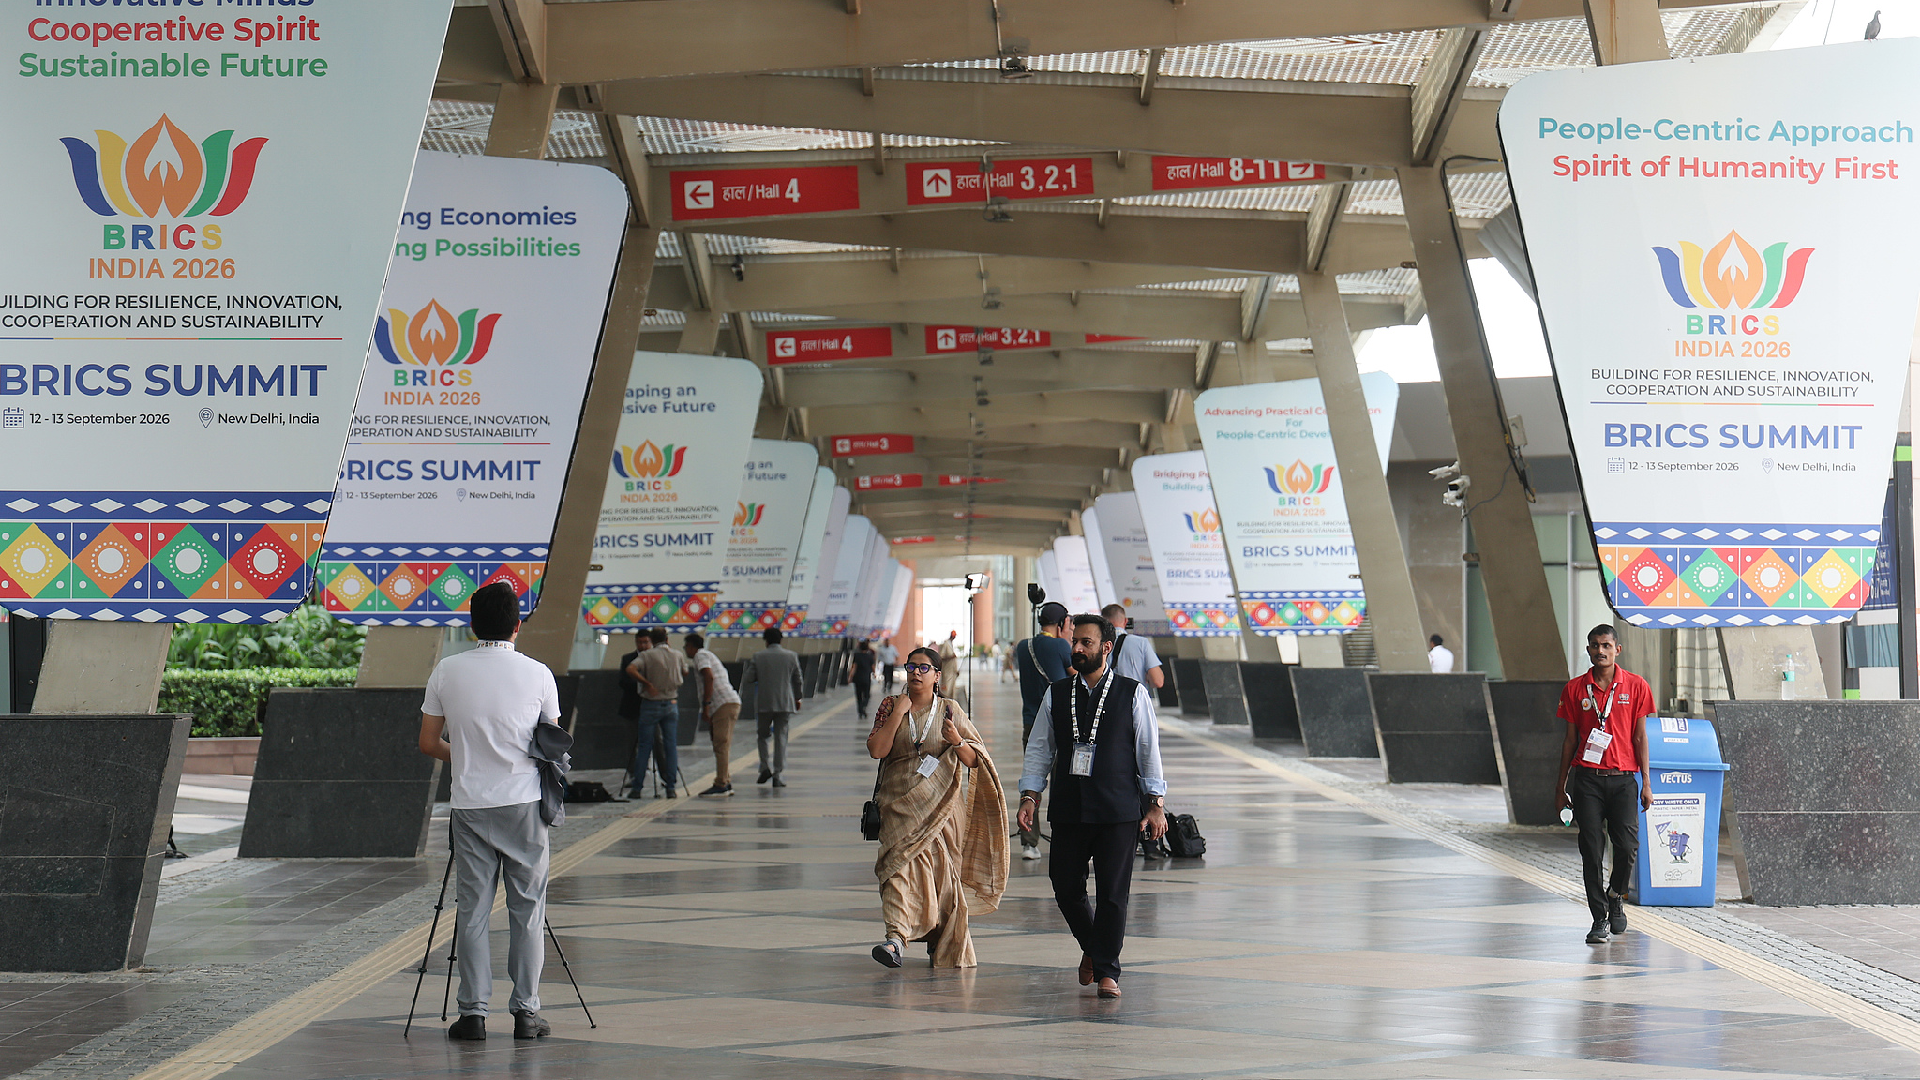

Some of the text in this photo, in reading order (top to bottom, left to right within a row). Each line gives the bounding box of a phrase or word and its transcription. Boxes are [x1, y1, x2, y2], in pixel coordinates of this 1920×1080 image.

[28, 15, 320, 47] Cooperative Spirit
[19, 51, 328, 78] Sustainable Future
[1539, 117, 1913, 147] People-Centric Approach
[1228, 158, 1282, 182] 8-11
[1553, 154, 1899, 185] Spirit of Humanity First
[1020, 164, 1077, 192] 3,2,1
[722, 186, 746, 201] हाल
[785, 178, 801, 203] 4
[440, 205, 577, 226] Economies
[103, 224, 222, 250] BRICS
[435, 237, 581, 257] Possibilities
[89, 258, 236, 279] INDIA 2026
[74, 295, 110, 309] FOR
[115, 295, 221, 311] RESILIENCE,
[226, 295, 342, 311] INNOVATION,
[2, 315, 324, 328] COOPERATION AND SUSTAINABILITY
[1686, 314, 1779, 336] BRICS
[842, 335, 853, 353] 4
[1675, 340, 1791, 358] INDIA 2026
[0, 364, 327, 397] BRICS SUMMIT
[394, 369, 472, 387] BRICS
[1591, 368, 1874, 384] BUILDING FOR RESILIENCE, INNOVATION,
[624, 384, 697, 399] aping an
[1606, 384, 1859, 398] COOPERATION AND SUSTAINABILITY
[384, 391, 481, 406] INDIA 2026
[622, 400, 716, 414] sive Future
[1205, 407, 1262, 417] Advancing
[1266, 407, 1313, 416] Practical
[30, 413, 42, 424] 12
[52, 413, 64, 424] 13
[67, 413, 137, 426] September
[140, 413, 170, 424] 2026
[218, 413, 319, 426] New Delhi, India
[374, 415, 399, 425] FOR
[402, 415, 472, 426] RESILIENCE,
[474, 415, 551, 426] INNOVATION,
[1286, 419, 1303, 427] For
[415, 427, 442, 438] AND
[444, 427, 538, 438] SUSTAINABILITY
[1216, 430, 1297, 440] People-Centric
[1604, 423, 1863, 449] BRICS SUMMIT
[880, 437, 889, 450] 3
[337, 459, 541, 482] RICS SUMMIT
[1628, 461, 1639, 471] 12
[1646, 461, 1656, 471] 13
[1657, 461, 1713, 472] September
[1715, 461, 1739, 471] 2026
[1777, 462, 1856, 473] New Delhi, India
[748, 472, 786, 481] Future
[893, 474, 902, 487] 3
[1154, 470, 1195, 479] Bridging
[624, 480, 672, 492] BRICS
[1162, 482, 1203, 491] Building
[369, 491, 415, 501] September
[417, 491, 438, 499] 2026
[469, 491, 536, 500] New Delhi, India
[620, 492, 678, 503] INDIA 2026
[1279, 497, 1321, 506] BRICS
[1273, 508, 1299, 517] INDIA
[643, 532, 714, 548] SUMMIT
[1243, 545, 1358, 558] BRICS SUMMIT
[732, 565, 783, 576] SUMMIT
[1166, 569, 1201, 579] BRICS
[1660, 772, 1692, 784] VECTUS
